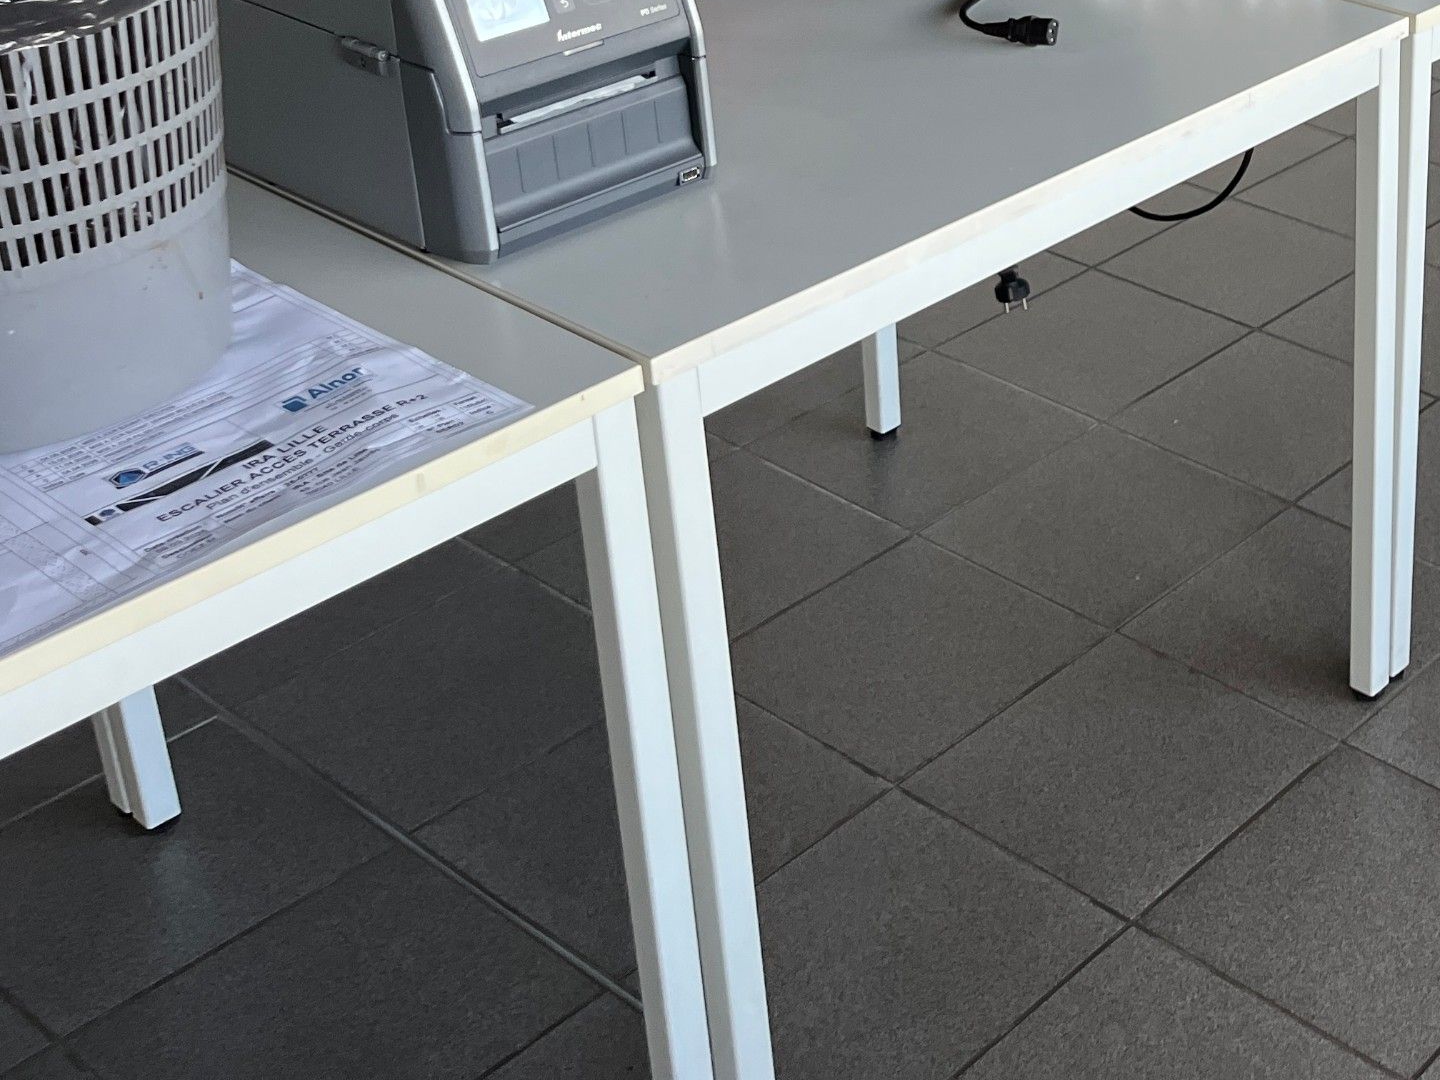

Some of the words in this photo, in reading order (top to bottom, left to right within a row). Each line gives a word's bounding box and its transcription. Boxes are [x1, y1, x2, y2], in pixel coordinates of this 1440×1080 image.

[557, 22, 603, 42] Intermec
[308, 367, 364, 399] Alnor
[156, 478, 247, 522] ESCALIER
[307, 404, 397, 449] TERRASSE
[241, 454, 277, 470] IRA
[277, 425, 329, 454] LILLE
[206, 494, 240, 510] Plan
